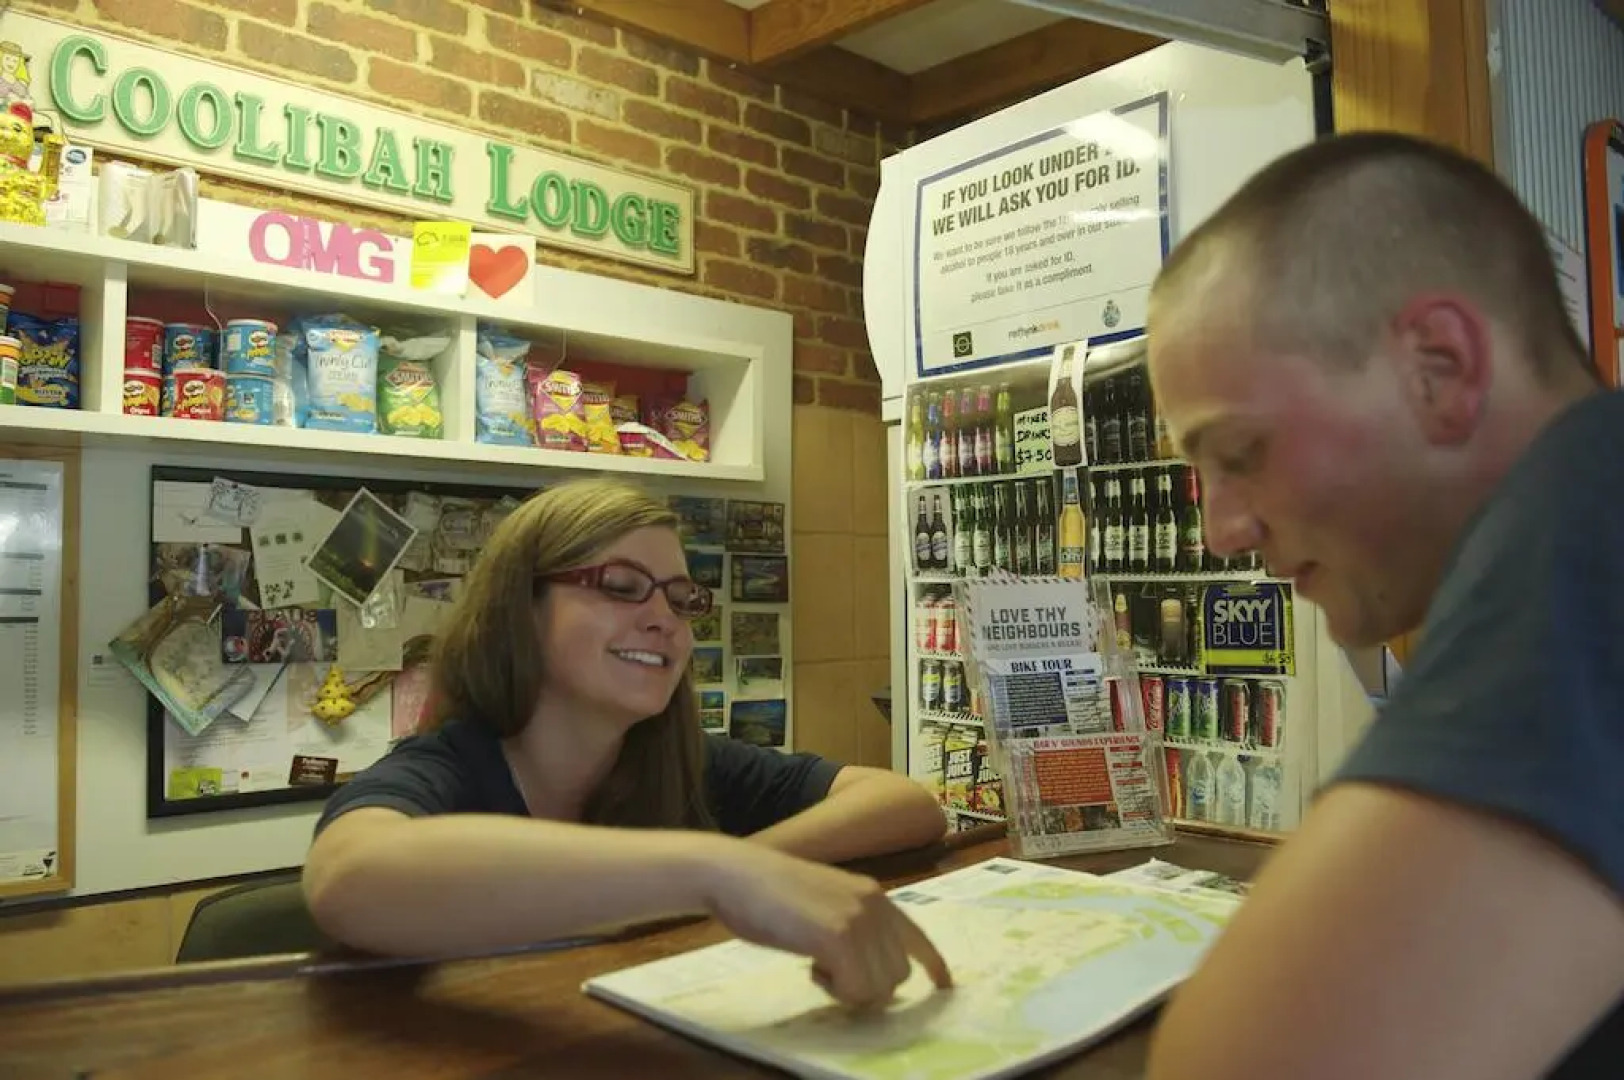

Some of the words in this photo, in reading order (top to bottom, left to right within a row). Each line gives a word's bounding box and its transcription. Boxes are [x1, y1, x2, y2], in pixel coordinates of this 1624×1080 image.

[50, 33, 454, 202] COOLIBAH
[485, 140, 680, 255] LODGE
[942, 190, 956, 211] IF
[959, 177, 988, 204] YOU
[993, 162, 1035, 193] LOOK
[1039, 142, 1099, 176] UNDER
[933, 213, 955, 236] WE
[958, 201, 995, 228] WILL
[999, 189, 1032, 216] ASK
[1036, 177, 1069, 203] YOU
[1075, 164, 1110, 192] FOR
[248, 210, 394, 284] OMG
[990, 608, 1031, 624] LOVE
[1035, 606, 1067, 622] THY
[1213, 598, 1272, 623] SKYY
[982, 622, 1081, 640] NEIGHBOURS
[1212, 622, 1273, 645] BLUE
[1010, 660, 1037, 673] BIKE
[1041, 658, 1073, 671] TOUR
[949, 749, 970, 764] JUST
[946, 761, 973, 778] JUICE
